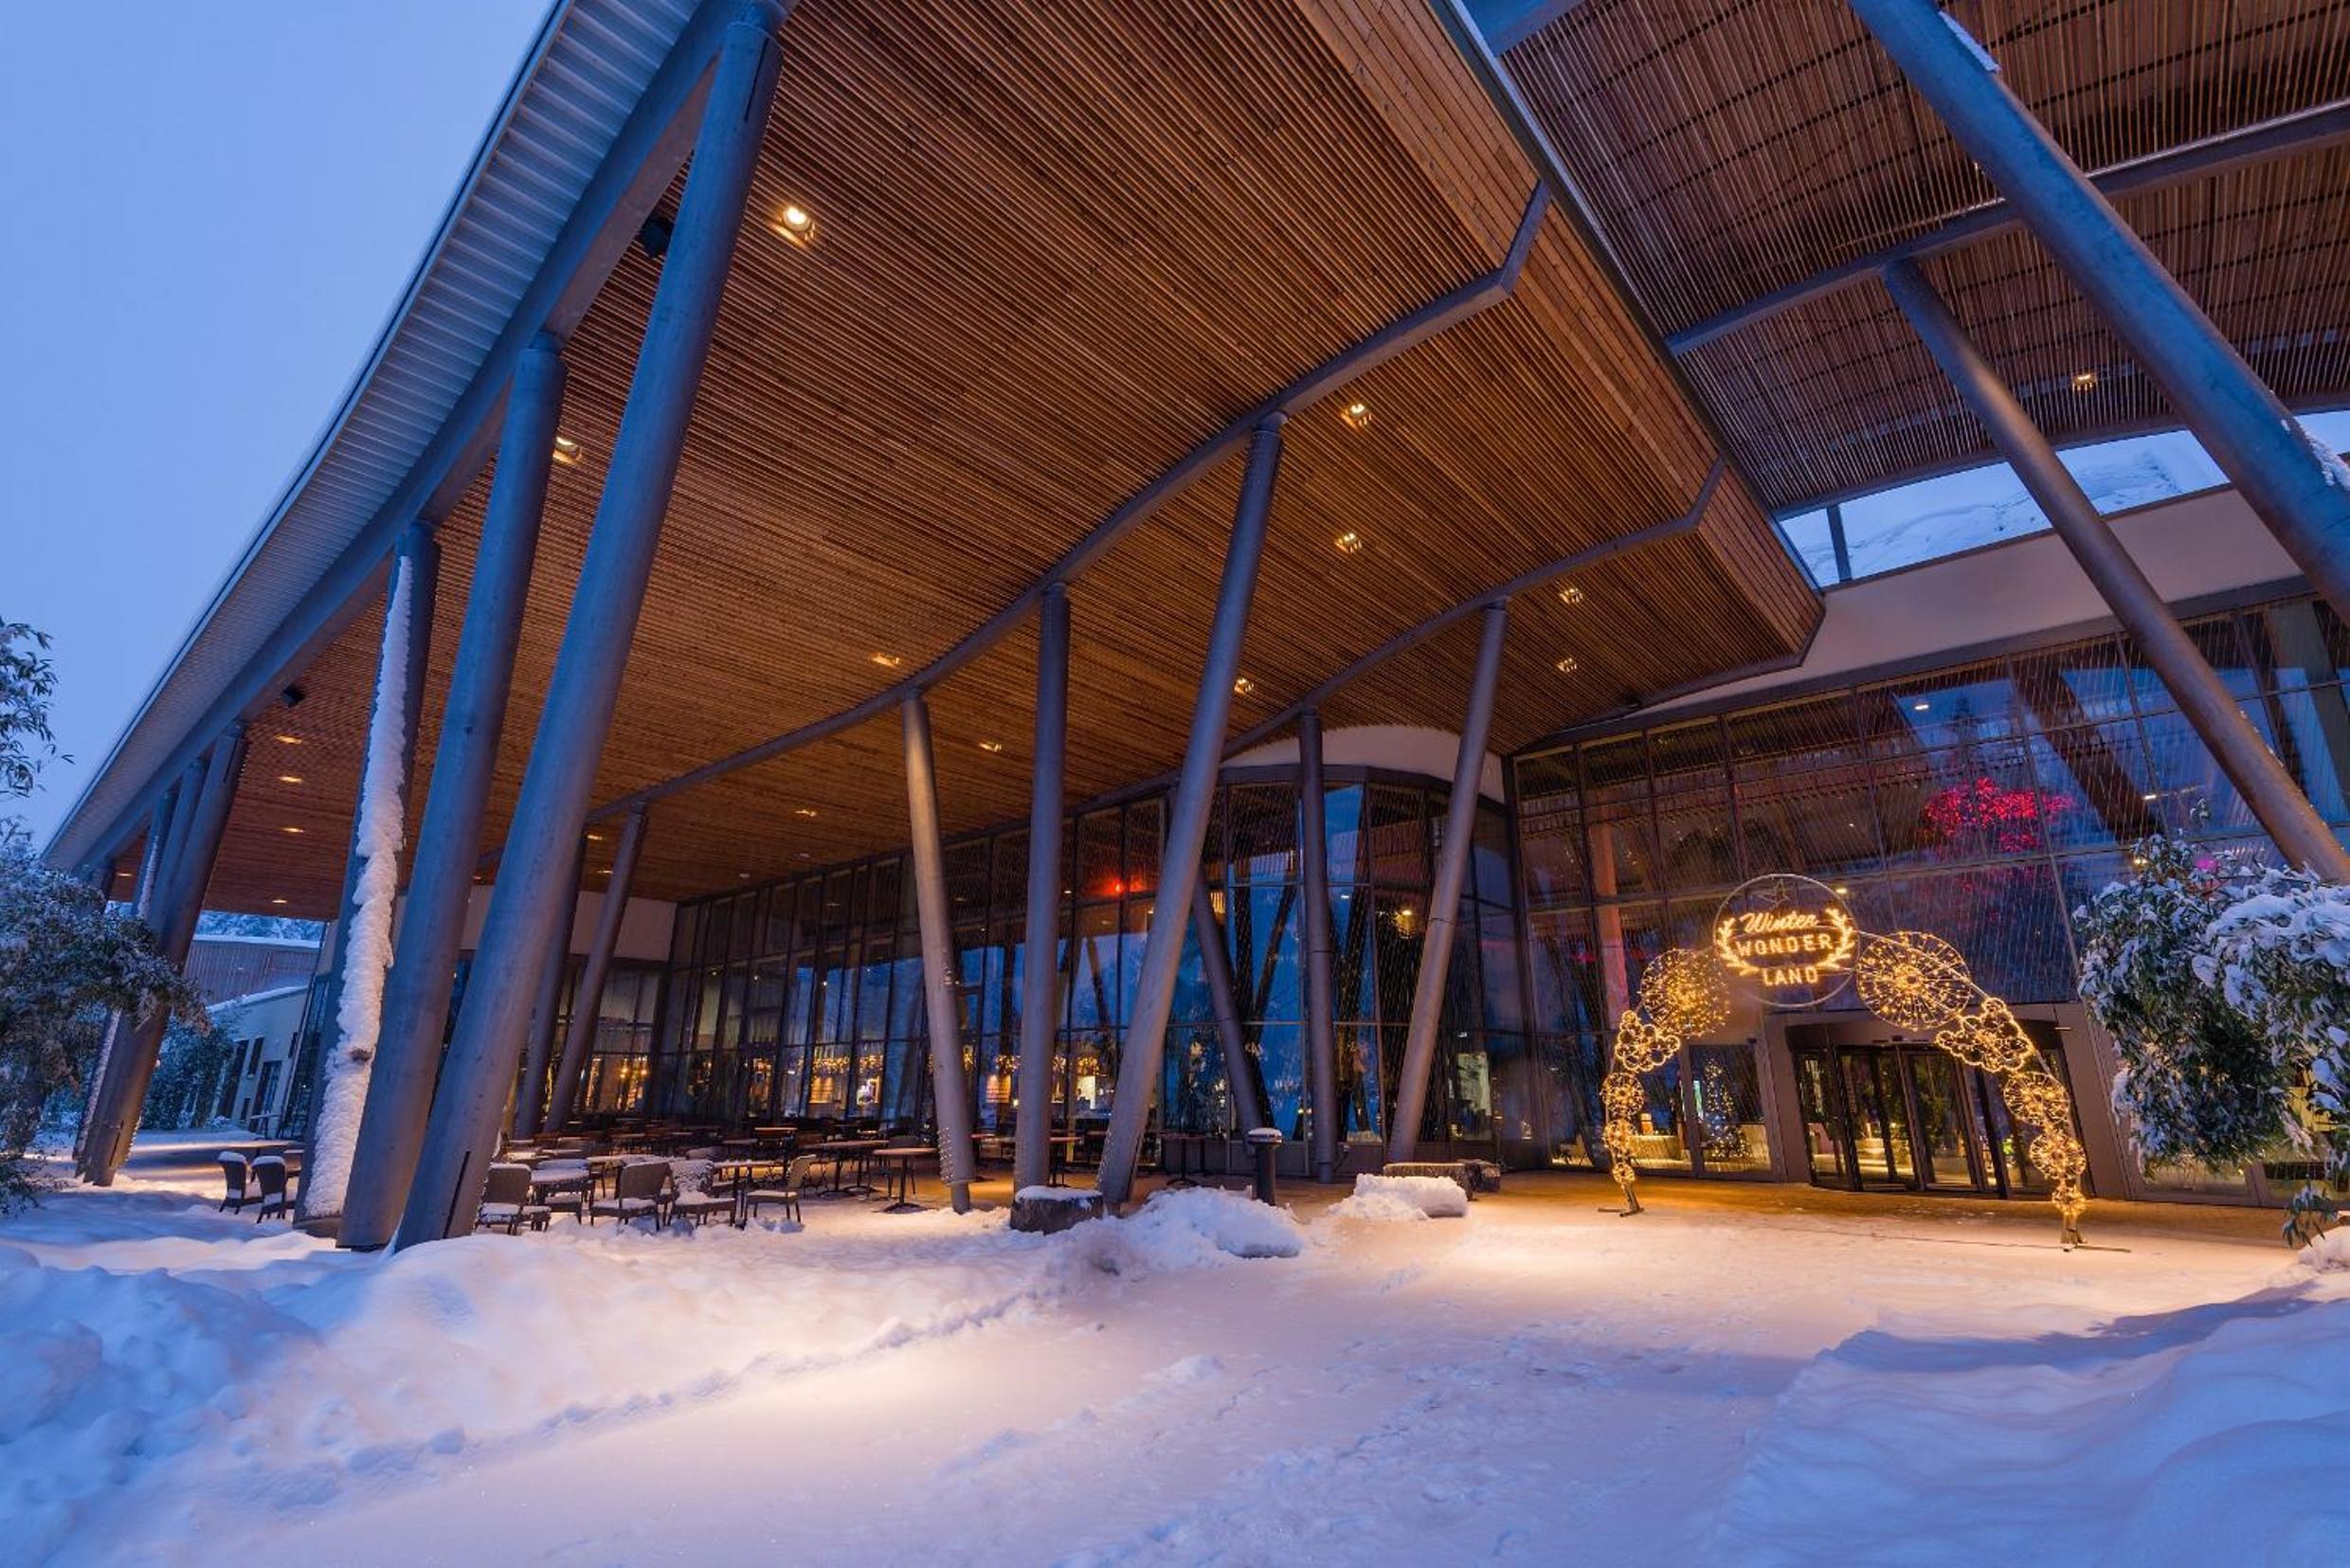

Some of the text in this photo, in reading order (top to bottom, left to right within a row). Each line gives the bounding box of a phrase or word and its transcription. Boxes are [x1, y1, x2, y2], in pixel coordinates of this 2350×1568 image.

[1740, 910, 1818, 933] Winter
[1735, 933, 1833, 957] WONDER
[1762, 966, 1818, 986] LAND
